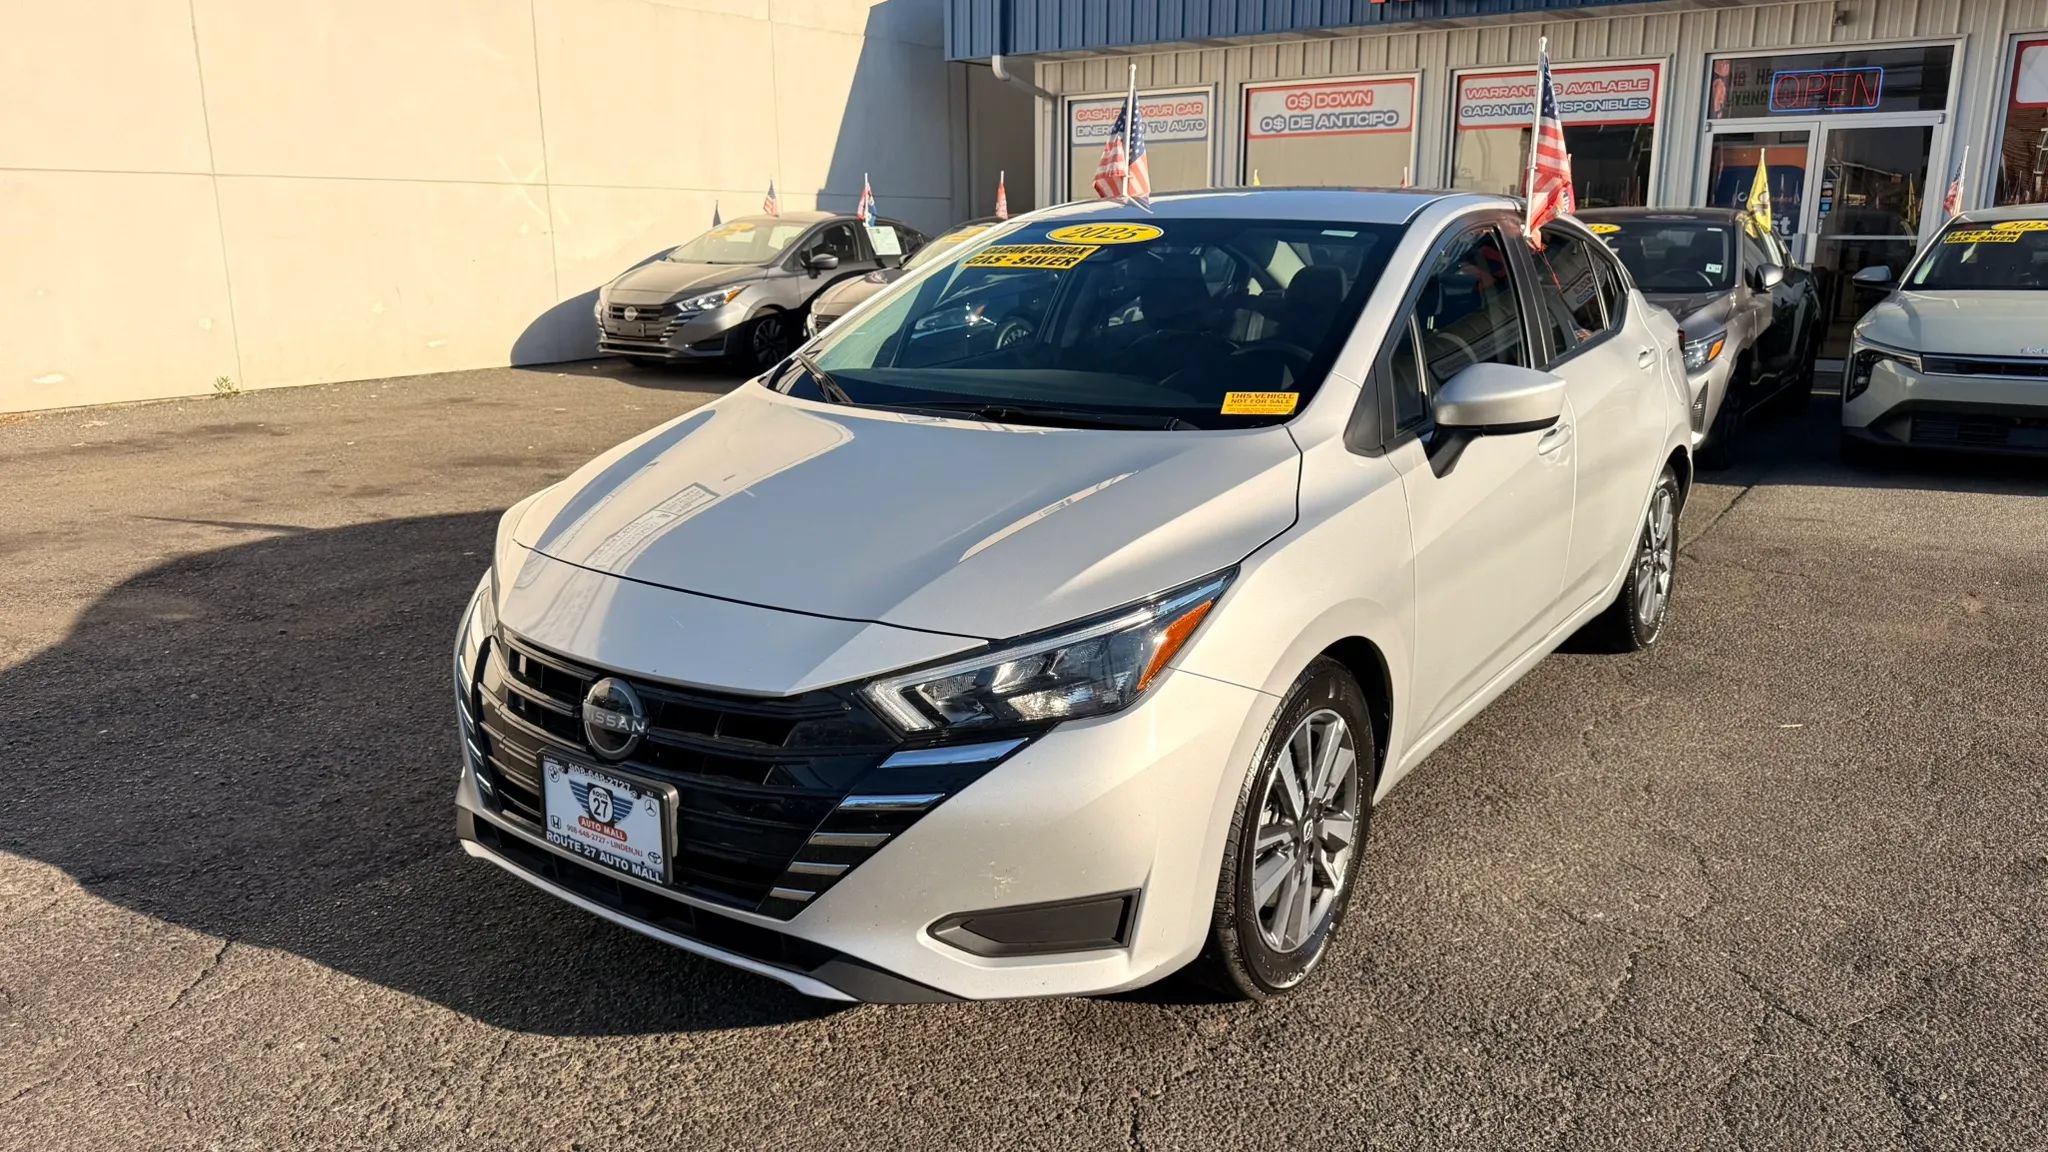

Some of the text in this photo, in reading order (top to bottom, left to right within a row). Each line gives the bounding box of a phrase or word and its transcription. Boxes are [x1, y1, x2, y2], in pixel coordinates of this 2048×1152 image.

[1315, 90, 1373, 109] DOWN
[1466, 78, 1649, 100] WARRANTS AVAILABLE
[1774, 71, 1880, 108] OPEN
[1076, 108, 1110, 121] CASH
[1142, 104, 1173, 117] YOUR
[1176, 102, 1204, 115] CAR
[1462, 98, 1651, 117] GARANTIA ISPONIBLES
[1148, 121, 1168, 133] TU
[1169, 119, 1207, 132] AUTO
[1289, 115, 1314, 131] DE
[1316, 110, 1399, 130] ANTICIPO
[1061, 226, 1149, 240] 2025
[965, 255, 1006, 265] GAS
[1012, 255, 1080, 266] SAVER
[584, 707, 646, 733] NISSAN
[593, 797, 608, 818] 27
[581, 818, 625, 840] AUTO MALL
[546, 831, 663, 884] ROUTE 27 AUTO MALL
